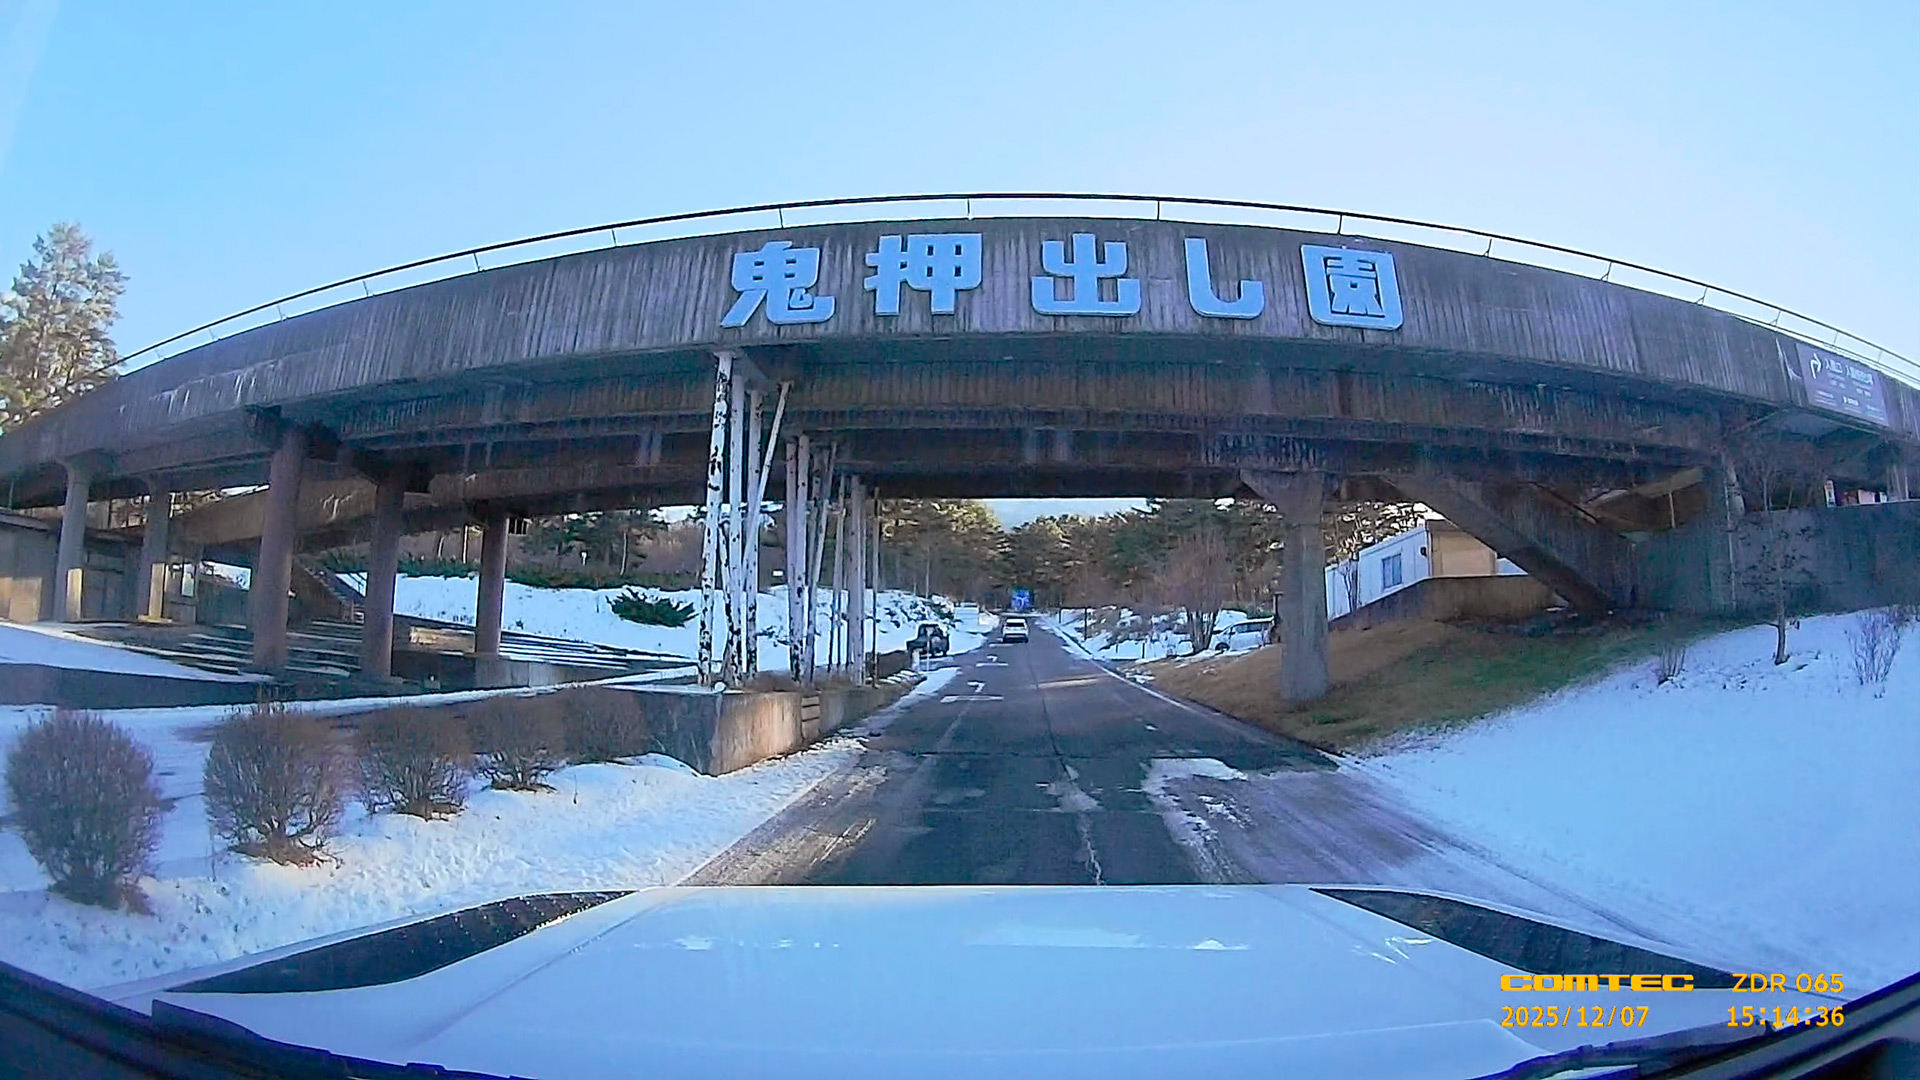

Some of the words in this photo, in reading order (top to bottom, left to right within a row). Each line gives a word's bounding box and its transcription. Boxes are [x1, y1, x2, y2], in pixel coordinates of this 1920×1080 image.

[721, 233, 1403, 331] 鬼押出し園
